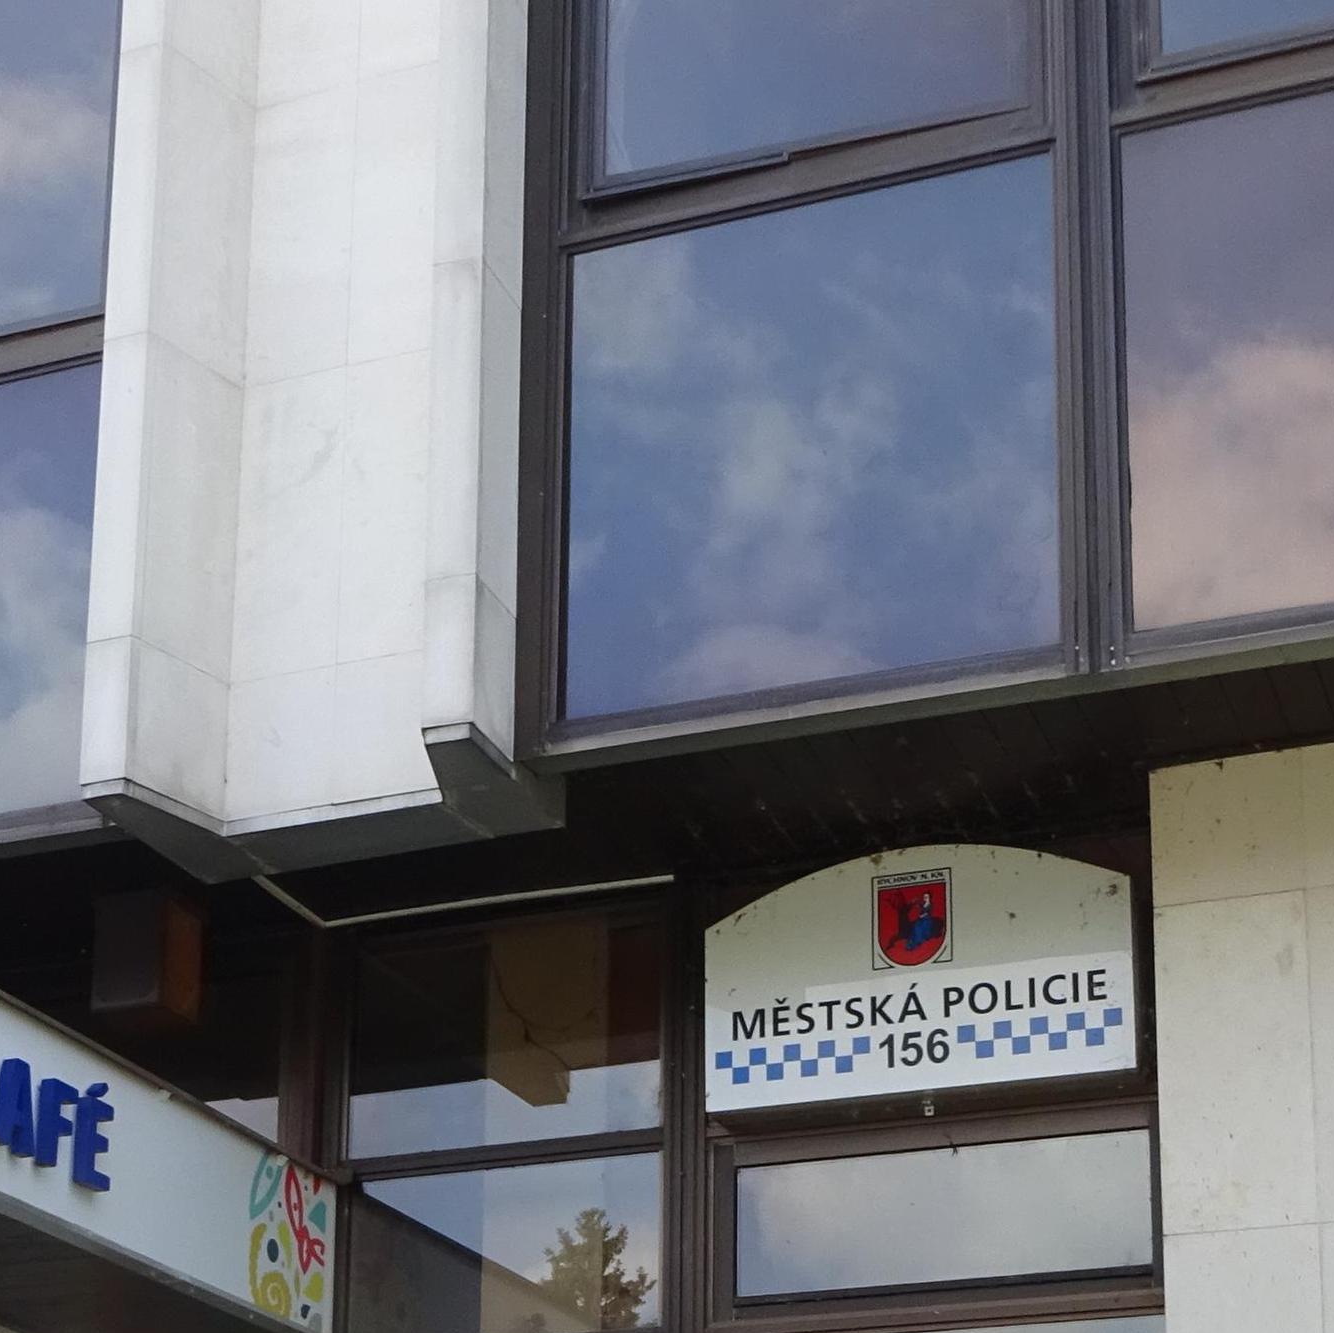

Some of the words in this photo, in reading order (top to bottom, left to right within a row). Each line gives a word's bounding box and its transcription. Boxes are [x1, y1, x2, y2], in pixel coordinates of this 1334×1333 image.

[732, 984, 926, 1041] MĚSTSKÁ
[944, 969, 1107, 1018] POLICIE
[878, 1028, 949, 1069] 156
